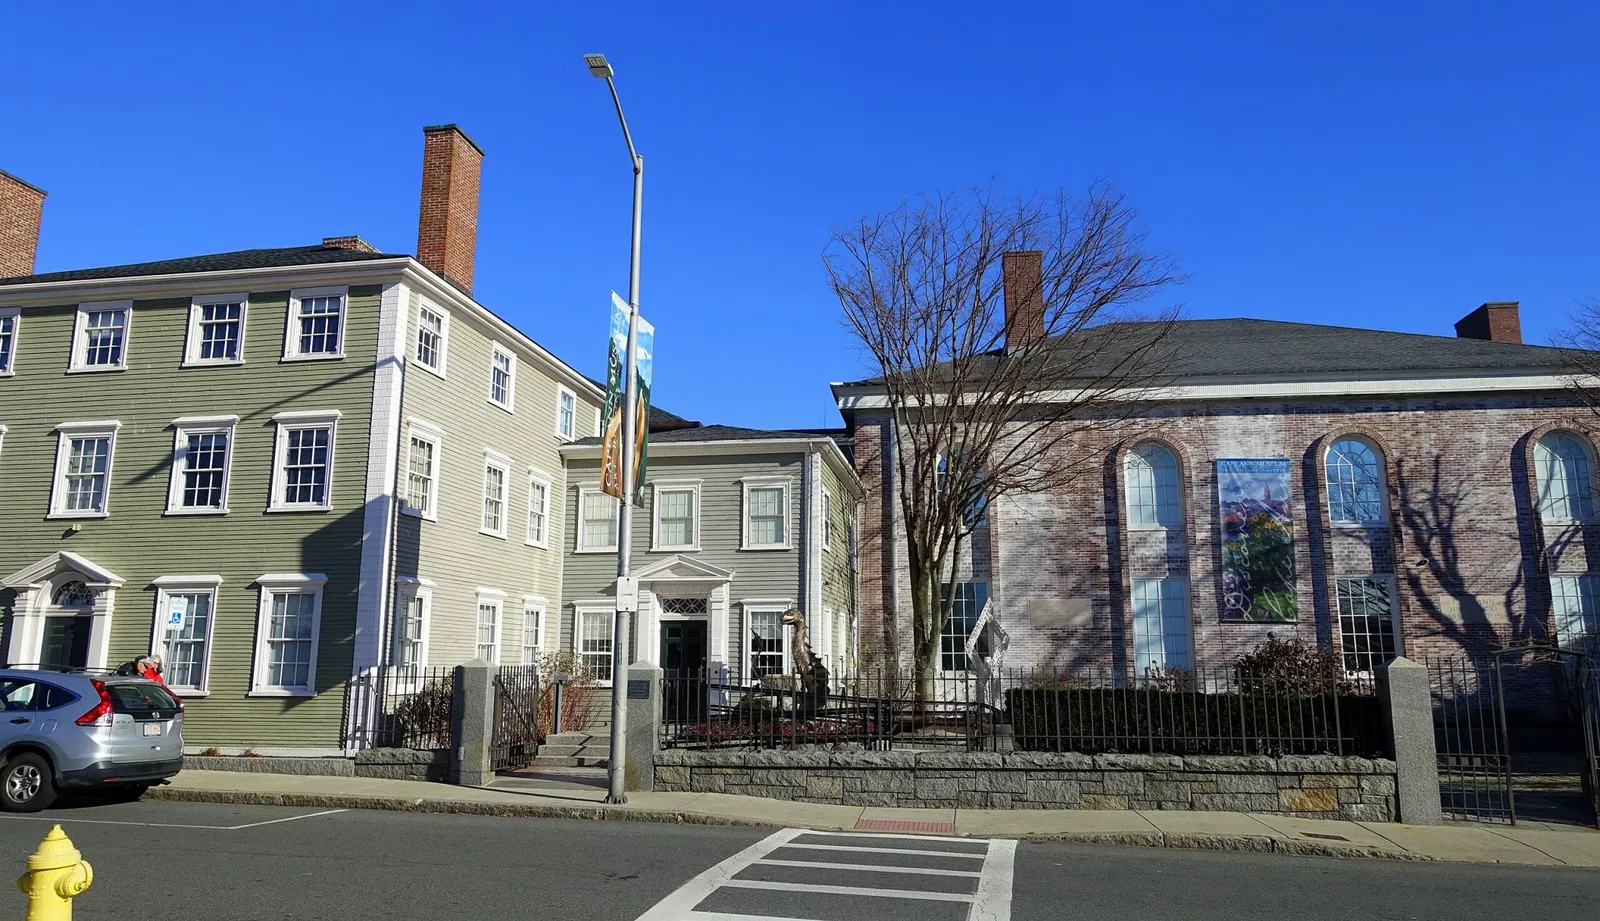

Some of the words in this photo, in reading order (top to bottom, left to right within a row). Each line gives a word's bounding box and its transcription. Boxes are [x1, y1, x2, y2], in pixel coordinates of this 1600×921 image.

[605, 440, 613, 487] CAPE
[609, 308, 620, 386] MUSEUM
[1224, 489, 1253, 621] Discover
[1262, 555, 1297, 622] Cape
